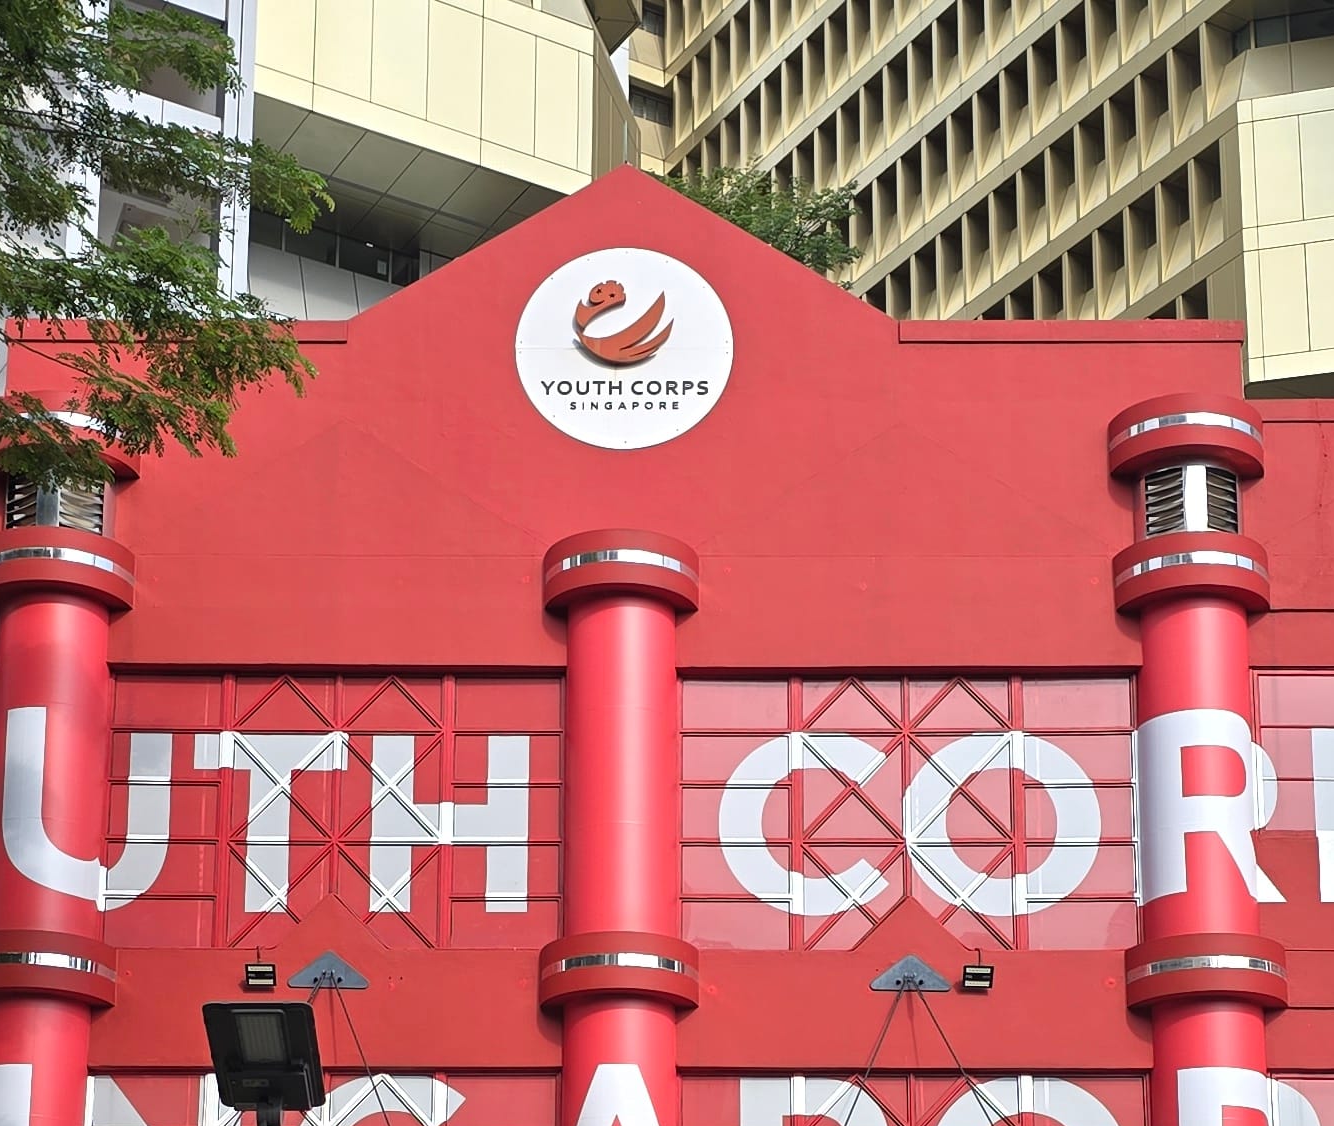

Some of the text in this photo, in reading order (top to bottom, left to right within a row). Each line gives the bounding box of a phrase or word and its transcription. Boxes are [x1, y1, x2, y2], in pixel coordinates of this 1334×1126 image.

[541, 380, 709, 396] YOUTH CORPS
[569, 401, 680, 411] SINGAPORE
